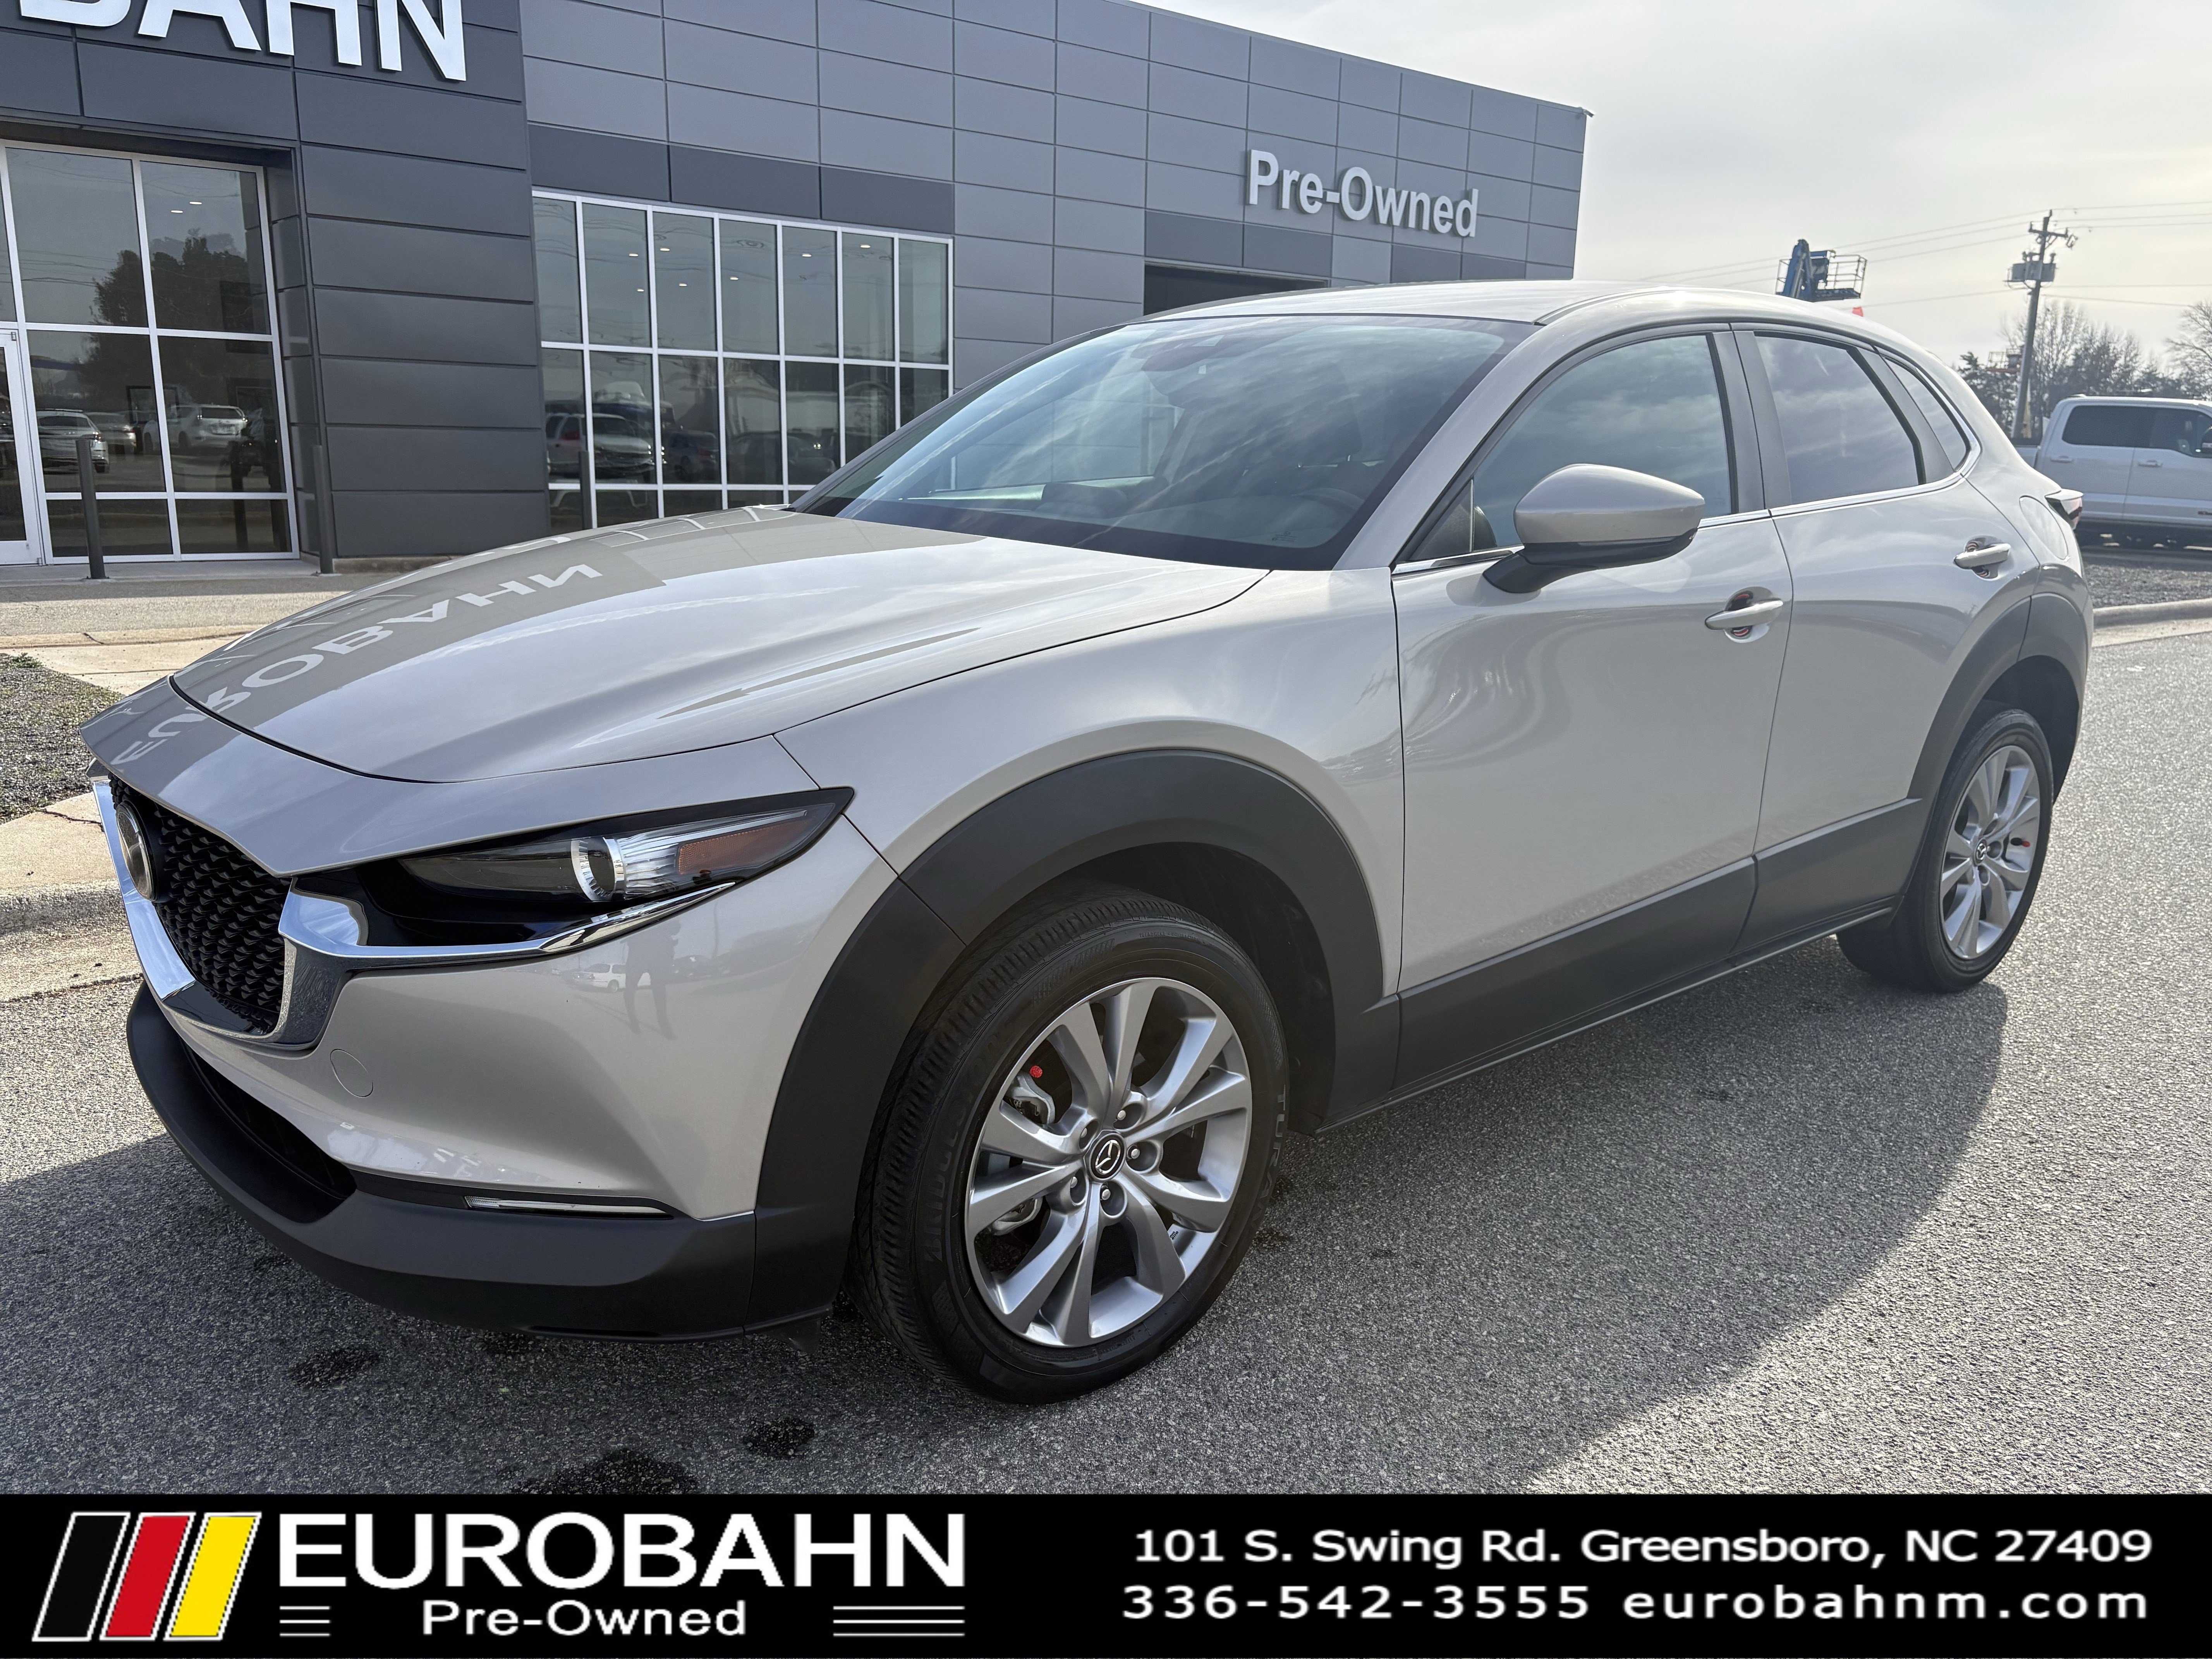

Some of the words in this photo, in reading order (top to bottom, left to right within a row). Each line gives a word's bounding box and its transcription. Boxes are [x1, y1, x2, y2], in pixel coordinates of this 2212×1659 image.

[19, 0, 466, 81] HN
[1247, 149, 1479, 237] Pre-Owned
[1244, 1083, 1286, 1241] TURAN
